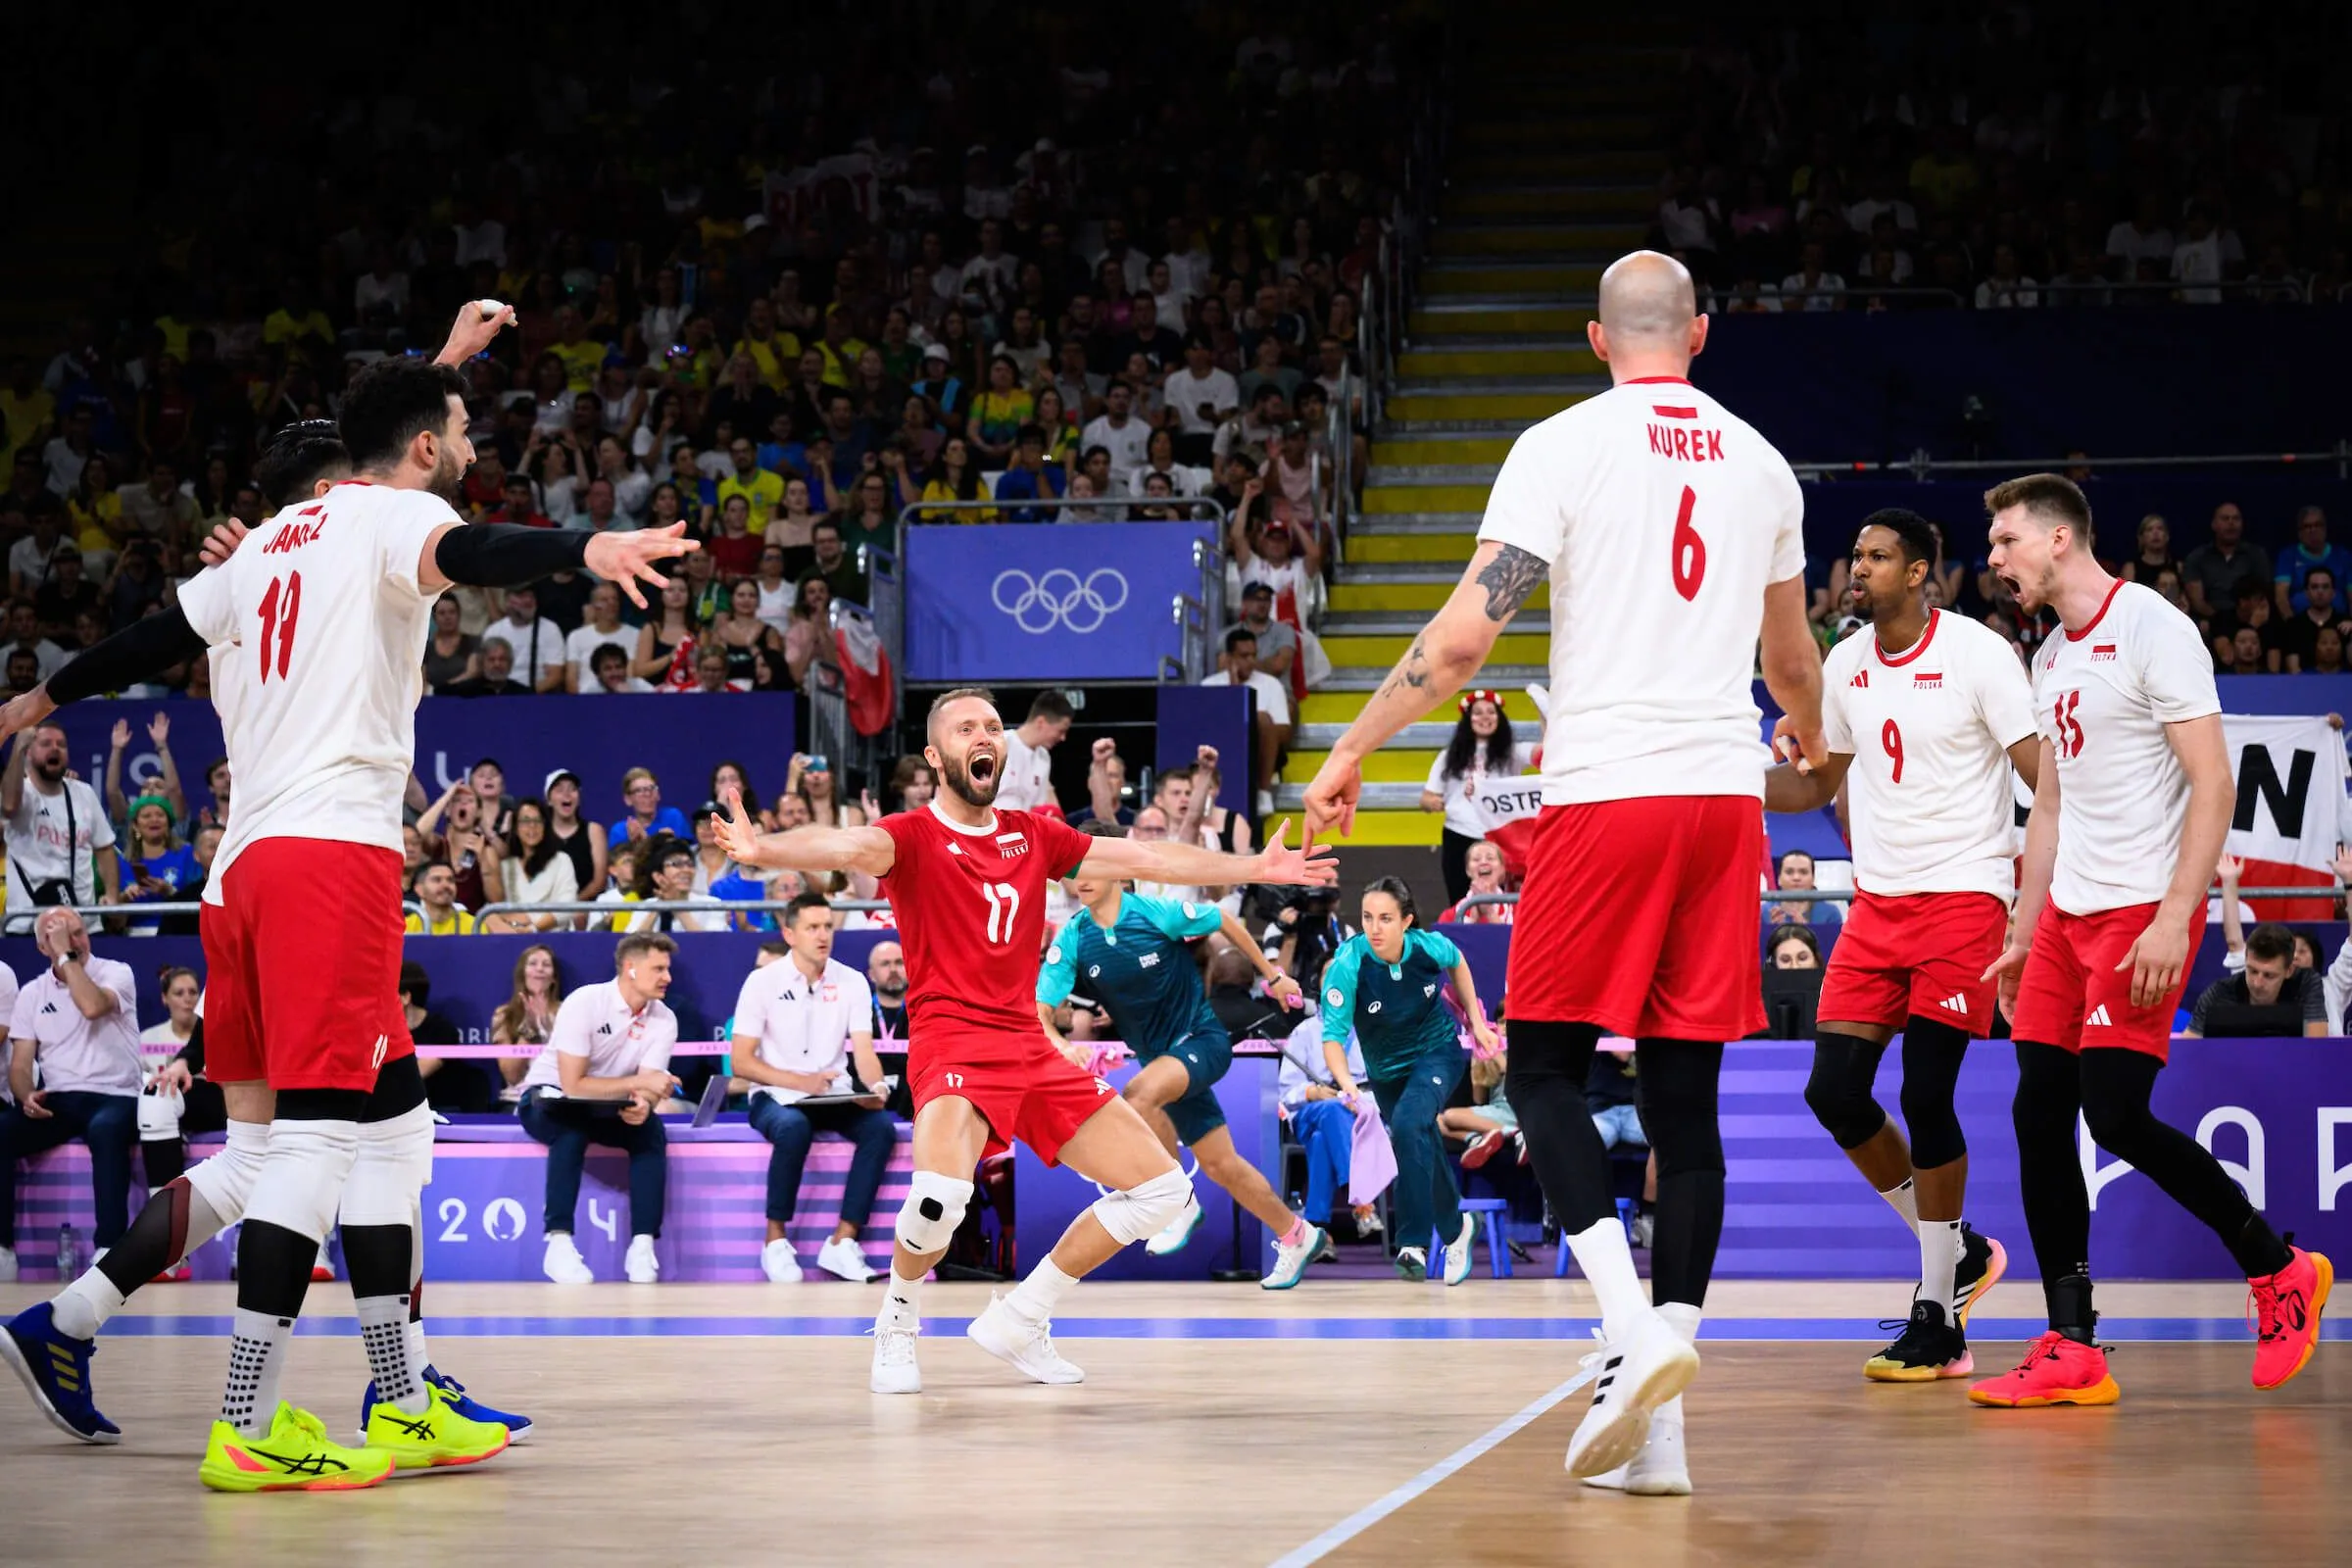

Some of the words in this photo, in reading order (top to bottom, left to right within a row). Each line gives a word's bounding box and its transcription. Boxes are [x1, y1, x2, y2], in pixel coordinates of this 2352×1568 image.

[1646, 423, 1725, 463] KUREK
[1672, 484, 1706, 603] 6
[258, 569, 302, 686] 19
[1913, 681, 1942, 690] POLSKA
[1882, 718, 1904, 784] 9
[2054, 690, 2084, 760] 15
[983, 882, 1019, 945] 17
[946, 1073, 963, 1089] 17
[439, 1198, 615, 1242] 204
